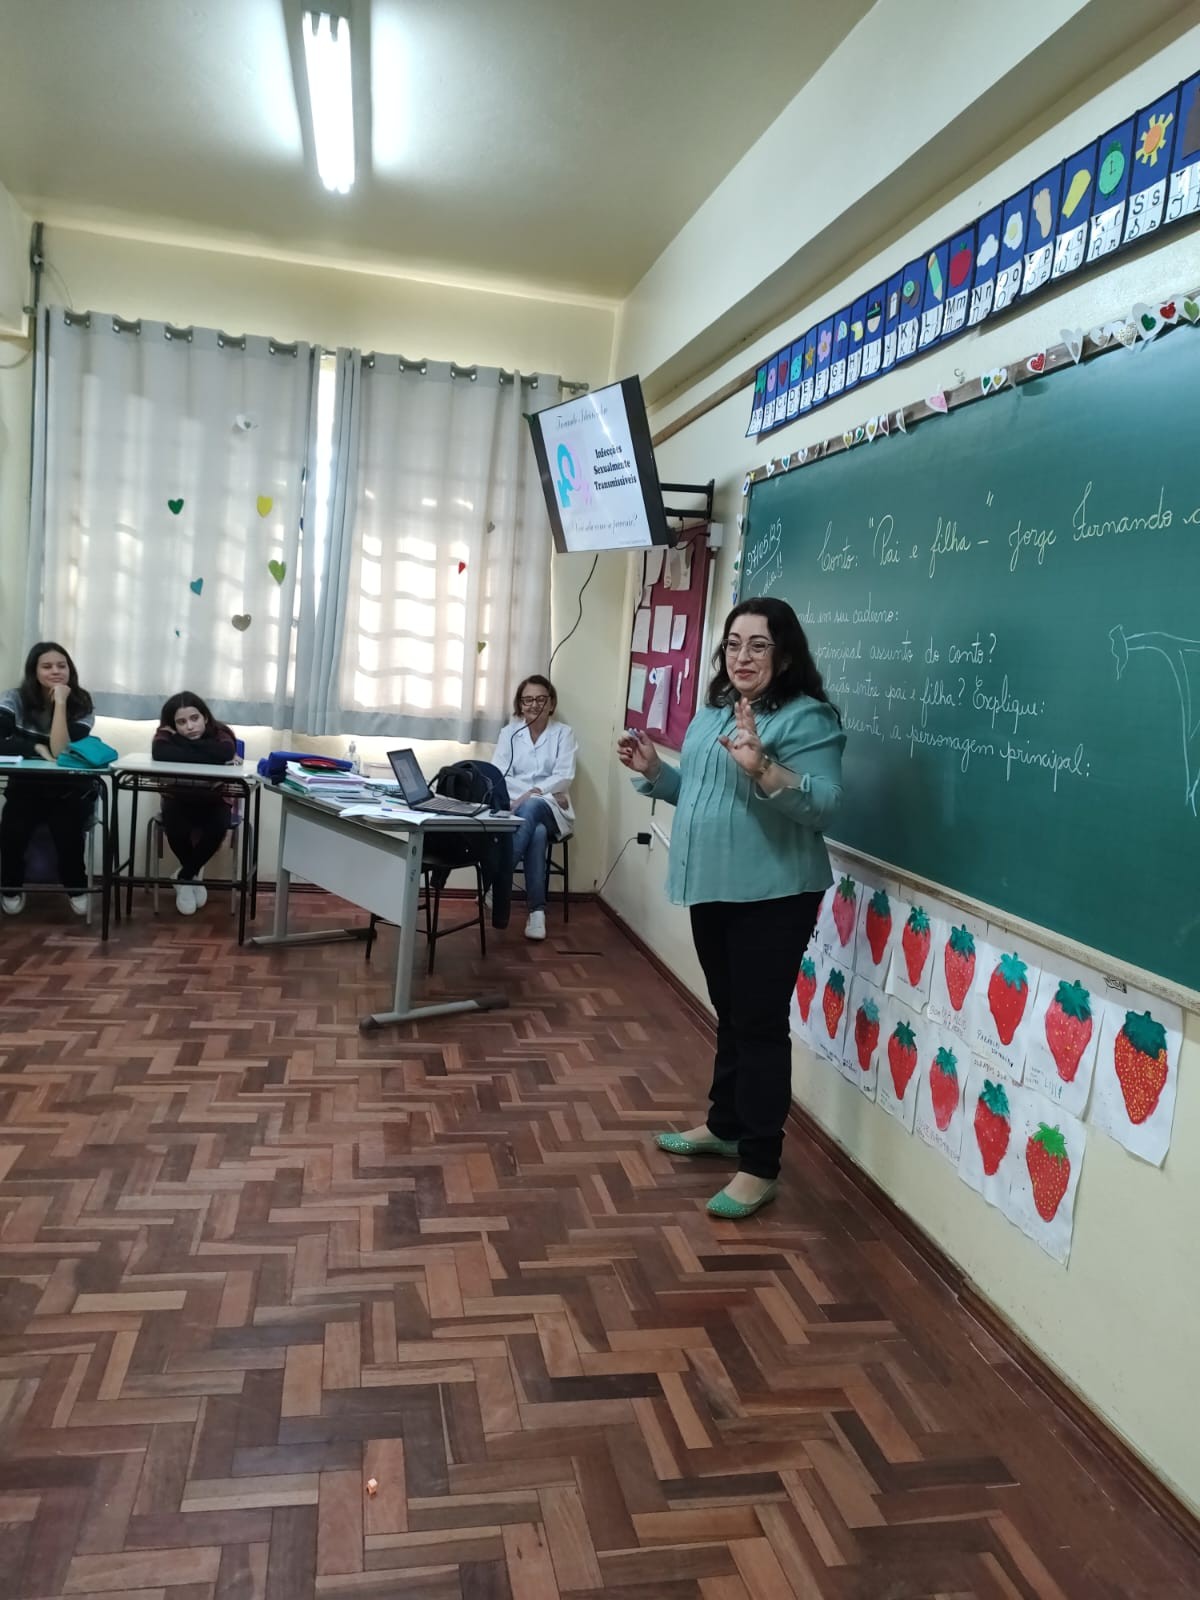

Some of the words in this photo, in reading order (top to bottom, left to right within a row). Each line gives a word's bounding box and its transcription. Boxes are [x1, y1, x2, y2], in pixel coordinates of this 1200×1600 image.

[1008, 519, 1057, 573] Jorge
[1072, 480, 1174, 542] Fernando
[949, 631, 997, 664] conto?
[972, 674, 1046, 735] Explique:
[906, 724, 995, 773] personagem
[999, 740, 1091, 793] principal:
